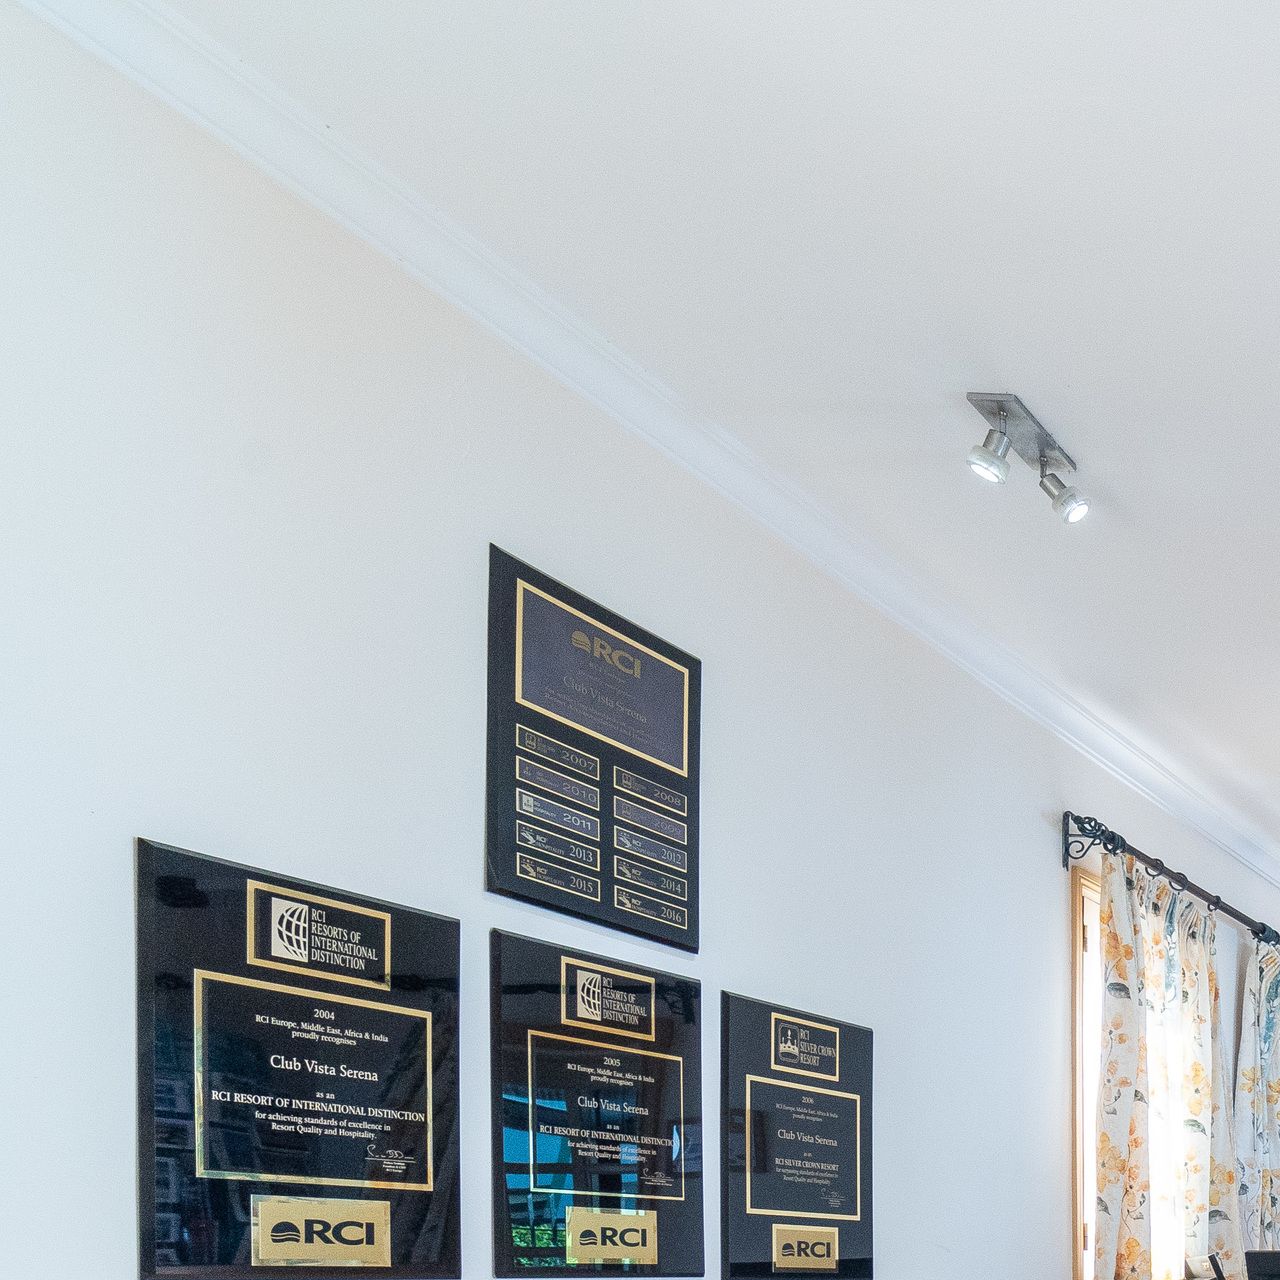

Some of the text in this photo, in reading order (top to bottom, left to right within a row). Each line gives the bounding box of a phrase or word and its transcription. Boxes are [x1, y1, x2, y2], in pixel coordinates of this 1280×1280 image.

[593, 636, 641, 679] RCI
[562, 750, 595, 771] 2007
[562, 782, 597, 803] 2010
[653, 789, 681, 806] 2008
[563, 813, 591, 830] 2011
[569, 845, 593, 863] 2013
[661, 848, 682, 865] 2012
[570, 876, 593, 893] 2015
[661, 877, 682, 894] 2014
[311, 908, 326, 923] RCI
[661, 906, 682, 923] 2016
[311, 922, 361, 944] RESORTS OF
[311, 935, 378, 960] INTERNATIONAL
[311, 949, 365, 970] DISTINCTION
[602, 977, 613, 988] RCI
[602, 987, 636, 1003] RESORTS OF
[313, 1008, 335, 1020] 2004
[602, 998, 647, 1017] INTERNATIONAL
[602, 1009, 639, 1025] DISTINCTION
[255, 1014, 389, 1042] RCI Europe, Middle East, Africa & India
[800, 1029, 810, 1041] RCI
[291, 1030, 357, 1046] proudly recognises
[800, 1041, 836, 1058] SILVER CROWN
[270, 1054, 378, 1081] Club Vista Serena
[603, 1057, 621, 1067] 2005
[800, 1053, 819, 1066] RESORT
[567, 1063, 576, 1071] RCI
[625, 1073, 638, 1081] Africa
[590, 1075, 609, 1084] proudly
[211, 1090, 425, 1122] RCI RESORT OF INTERNATIONAL DISTINCTION
[577, 1095, 649, 1116] Club Vista Serena
[255, 1110, 266, 1119] for
[268, 1113, 302, 1124] achieving
[304, 1117, 338, 1127] standards
[339, 1119, 347, 1127] of
[348, 1121, 382, 1131] excellence
[271, 1122, 377, 1140] Resort Quality and Hospitality.
[540, 1125, 552, 1134] RCI
[554, 1126, 580, 1137] RESORT
[580, 1129, 591, 1138] OF
[591, 1130, 640, 1143] INTERNATIONAL
[777, 1129, 838, 1147] Club Vista Serena
[576, 1141, 598, 1150] achieving
[775, 1157, 839, 1171] RCI SILVER CROWN RESORT
[304, 1219, 375, 1245] RCI
[601, 1227, 647, 1247] RCI
[797, 1241, 831, 1258] RCI
